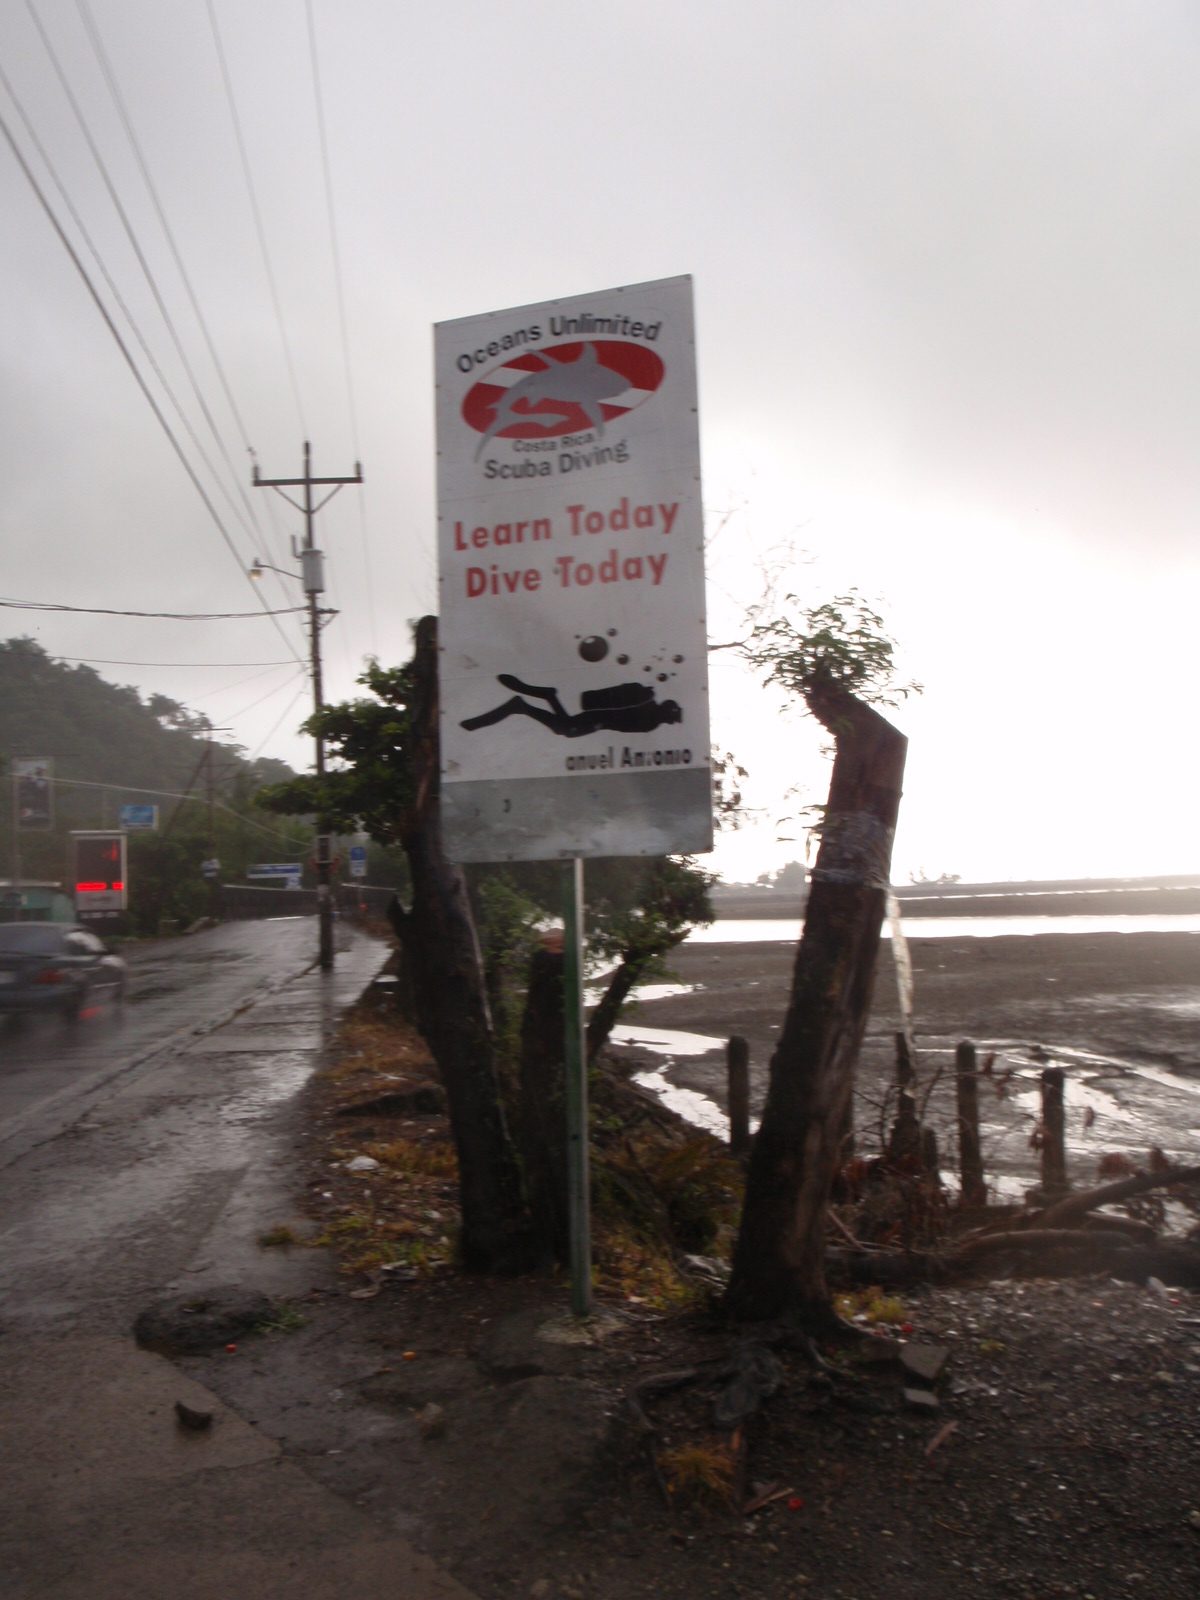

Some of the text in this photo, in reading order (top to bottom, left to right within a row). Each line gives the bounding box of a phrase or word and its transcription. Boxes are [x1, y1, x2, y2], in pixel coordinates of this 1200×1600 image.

[457, 313, 662, 373] Oceans Unlimited
[484, 439, 630, 479] Scuba Diving
[513, 432, 594, 453] Costa Rica
[454, 497, 680, 551] Learn Today
[466, 549, 669, 598] Dive Today
